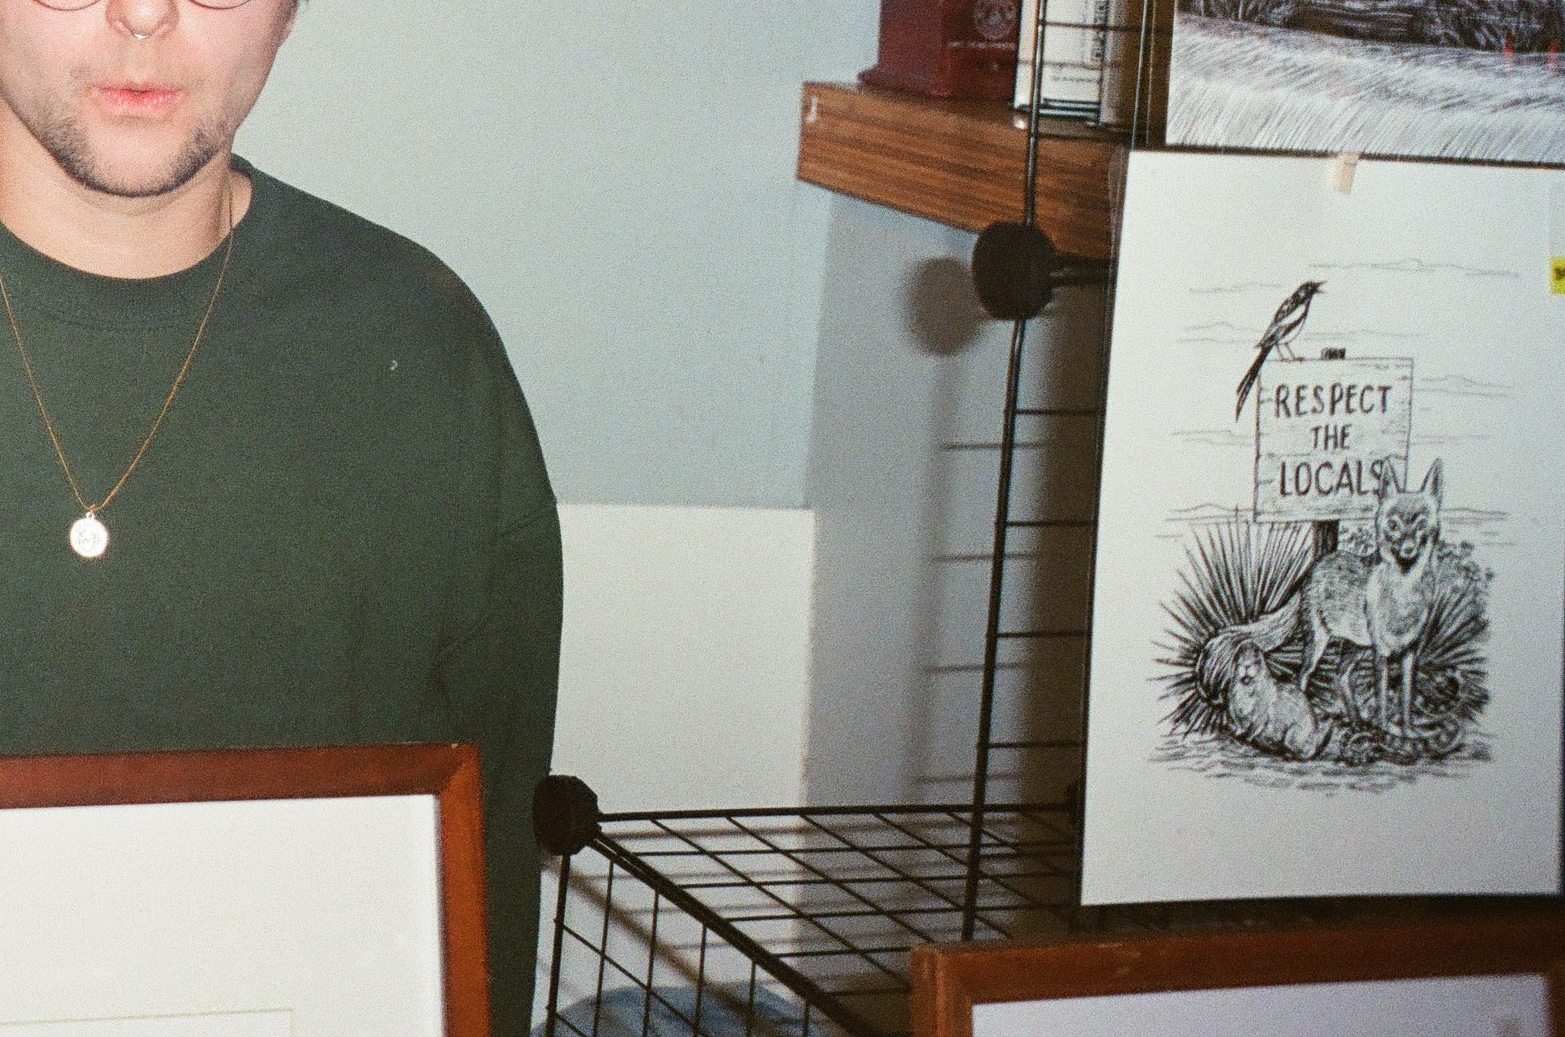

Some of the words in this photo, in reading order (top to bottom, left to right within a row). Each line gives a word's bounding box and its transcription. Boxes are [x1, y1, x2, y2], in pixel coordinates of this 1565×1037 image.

[1273, 382, 1393, 418] RESPECT
[1310, 422, 1353, 451] THE
[1279, 459, 1387, 497] LOCALS
